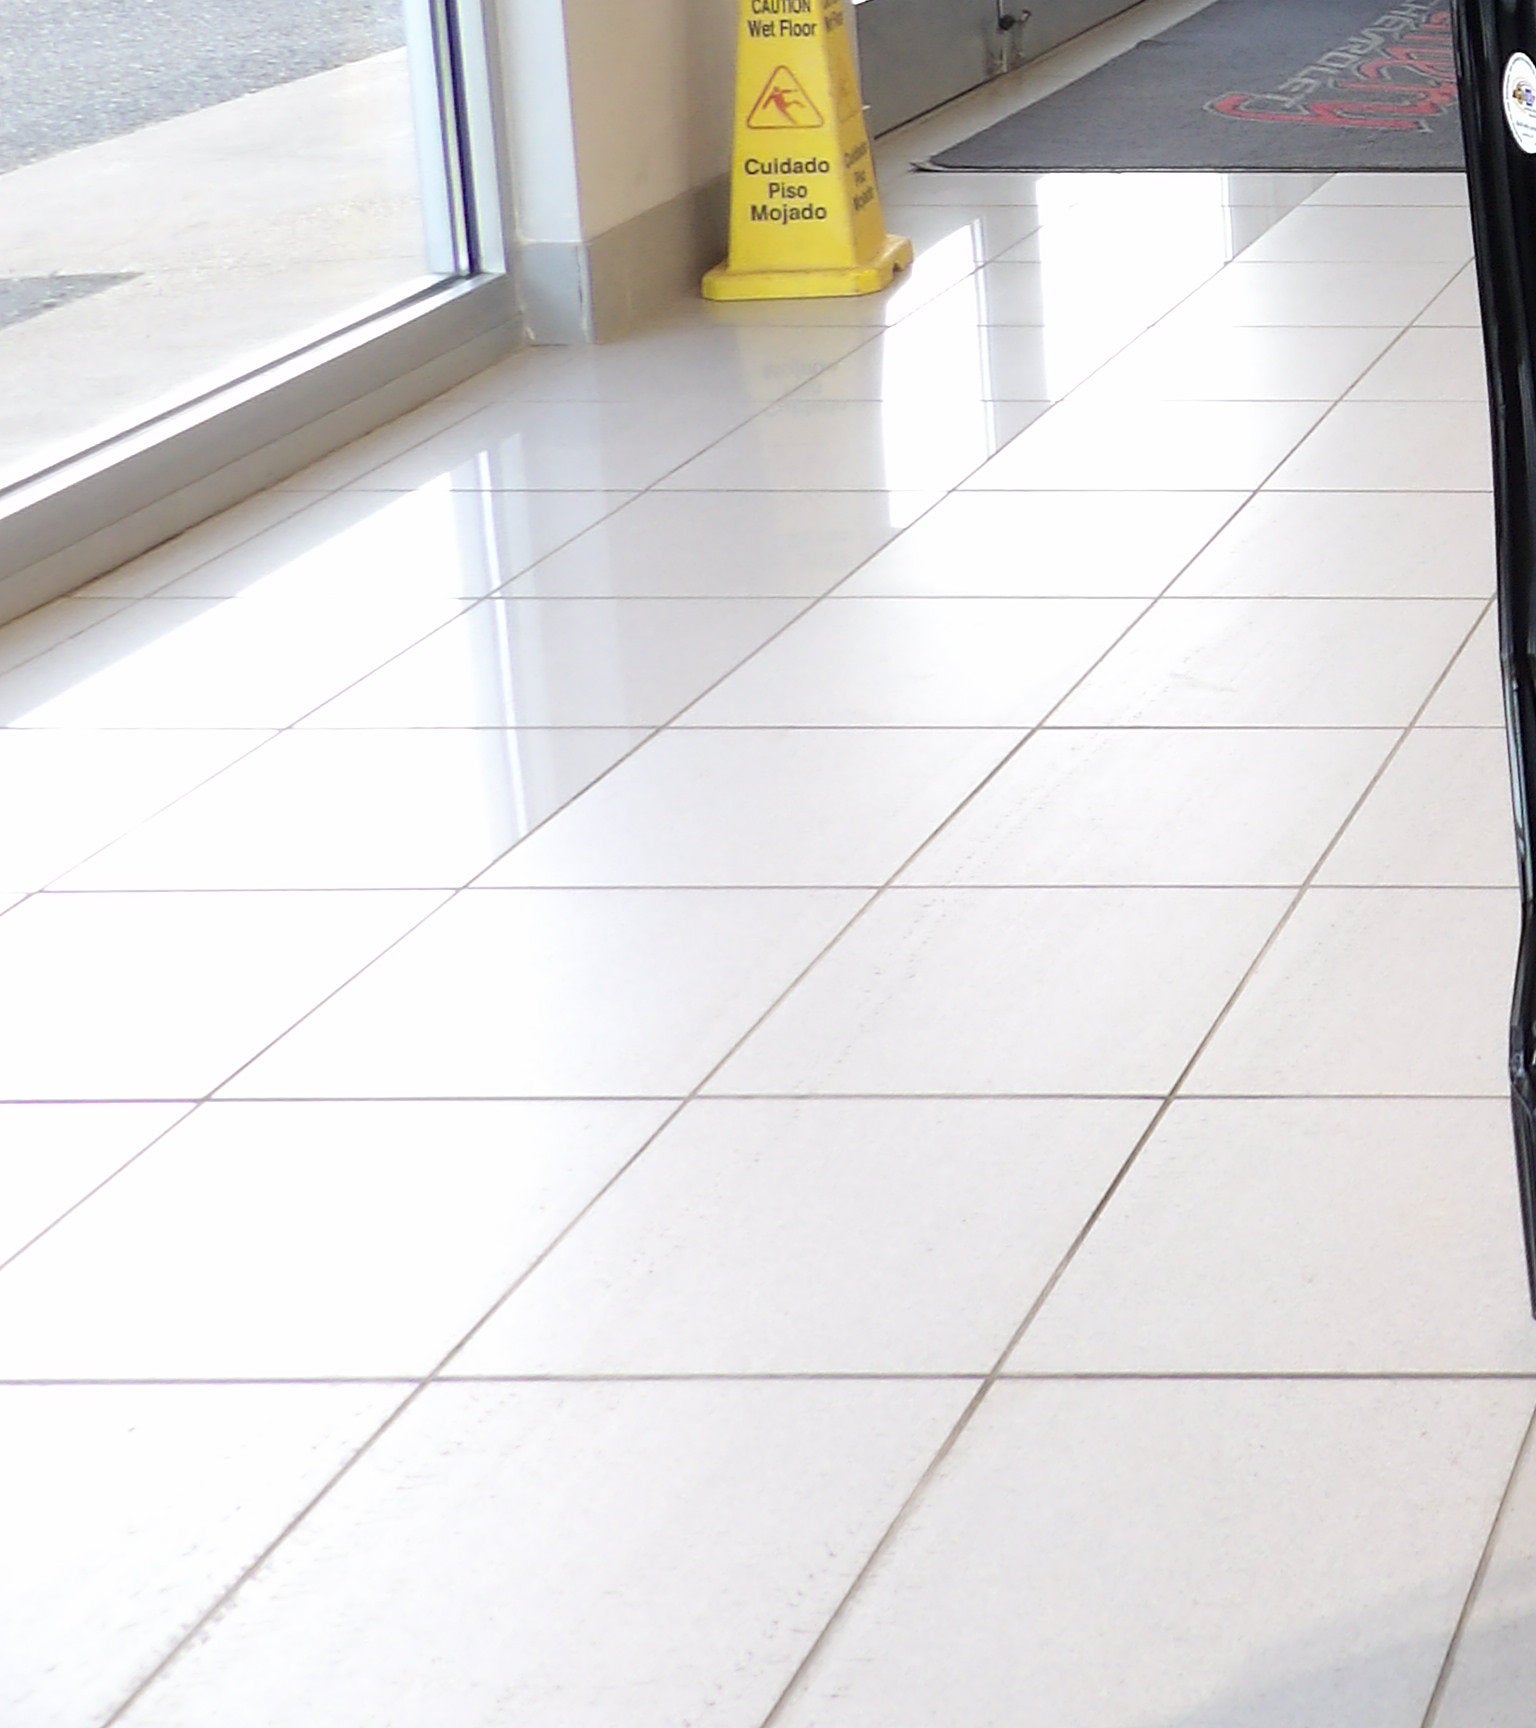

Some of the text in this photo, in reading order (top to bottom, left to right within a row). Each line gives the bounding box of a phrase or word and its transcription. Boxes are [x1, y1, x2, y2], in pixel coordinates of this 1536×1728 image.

[747, 19, 776, 37] Wet
[779, 19, 817, 37] Floor
[744, 157, 830, 175] Cuidado
[768, 182, 808, 199] Piso
[750, 203, 827, 225] Mojado
